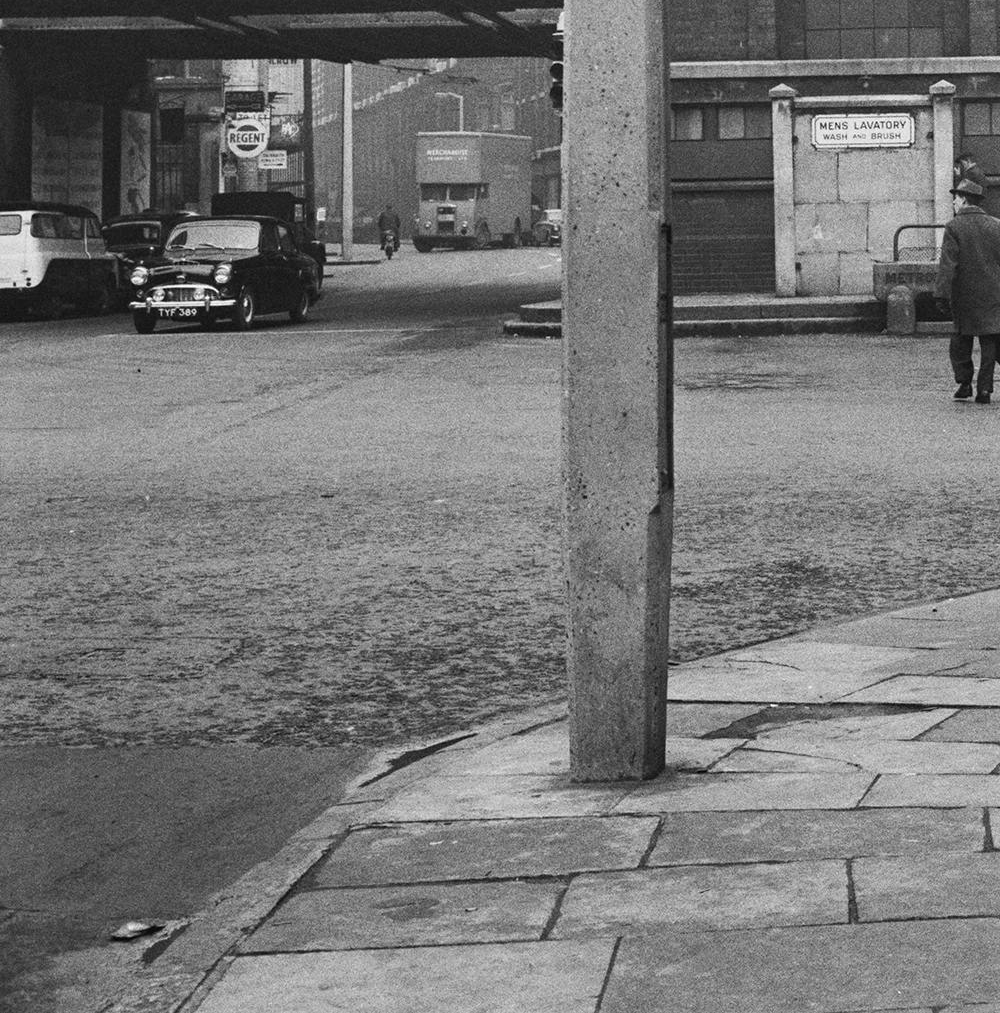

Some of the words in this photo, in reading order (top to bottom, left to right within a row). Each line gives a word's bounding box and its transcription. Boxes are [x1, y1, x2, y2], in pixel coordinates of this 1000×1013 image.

[820, 121, 848, 131] MENS
[854, 120, 906, 130] LAVATORY
[229, 132, 266, 144] REGENT
[823, 133, 848, 141] WASH
[871, 132, 901, 140] BRUSH
[158, 308, 176, 317] TYF
[179, 308, 198, 317] 389
